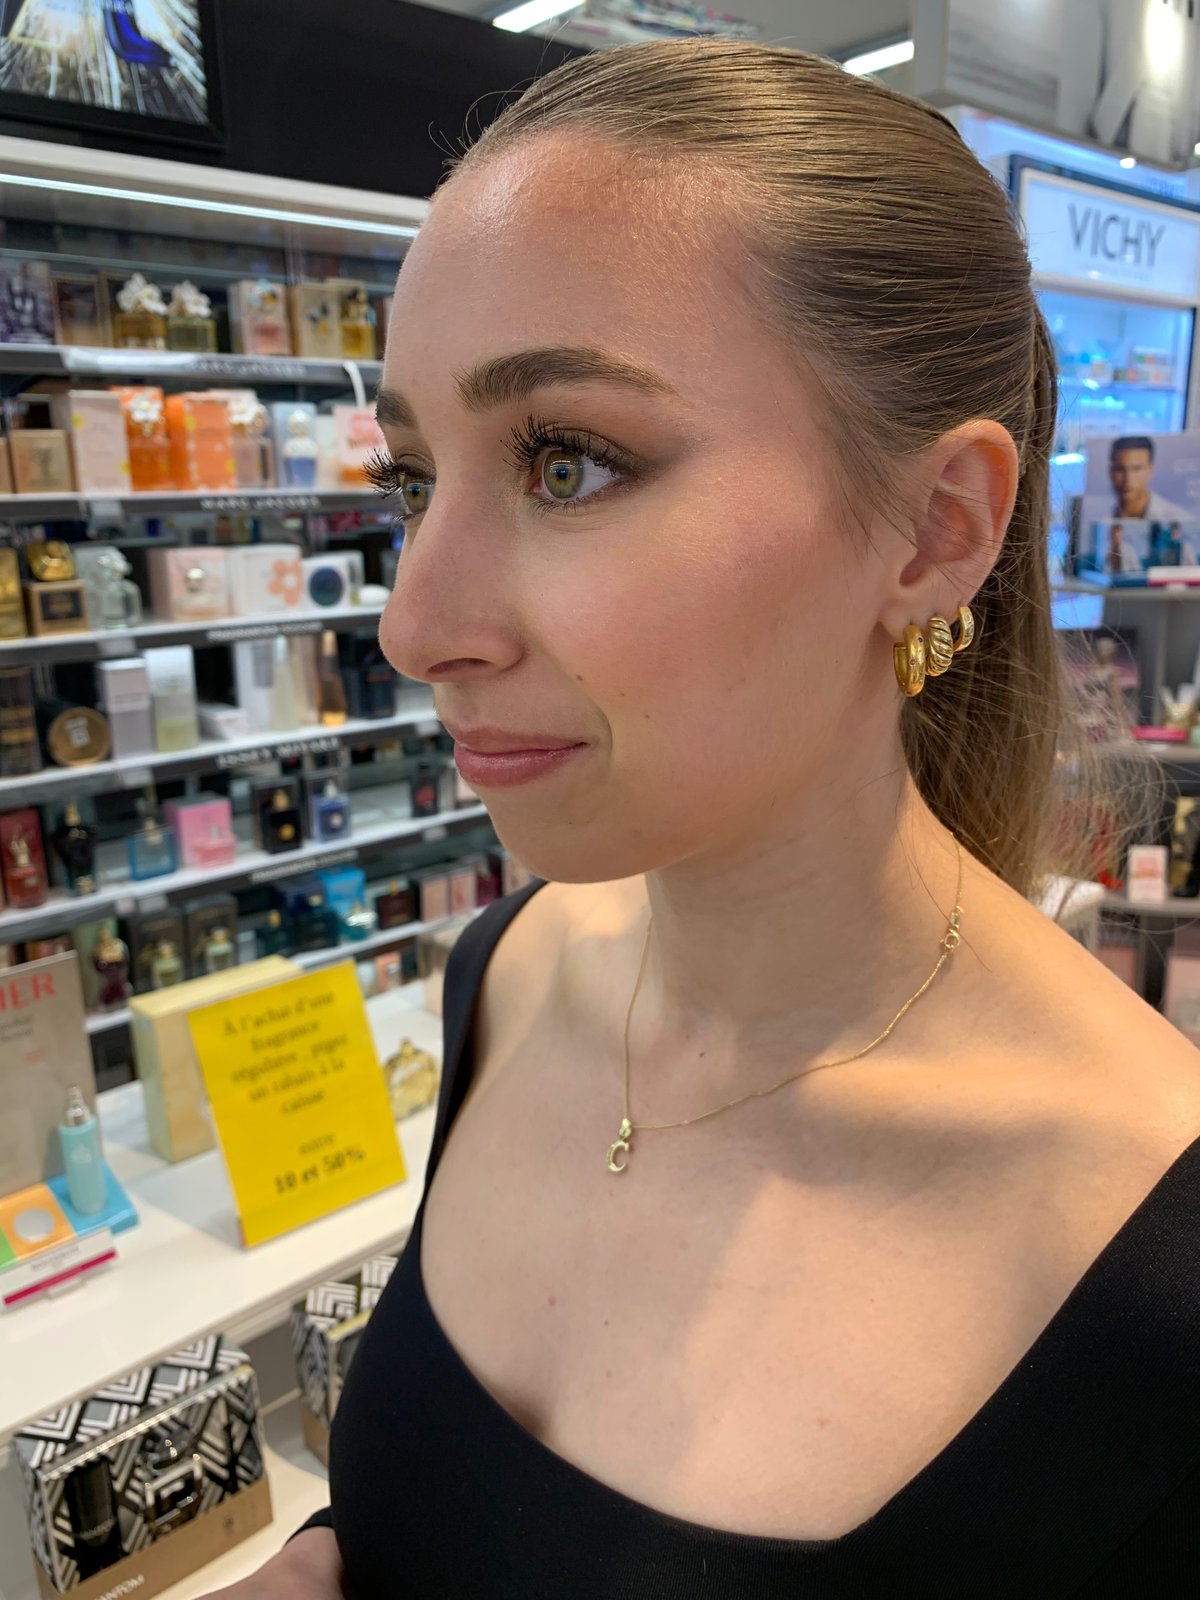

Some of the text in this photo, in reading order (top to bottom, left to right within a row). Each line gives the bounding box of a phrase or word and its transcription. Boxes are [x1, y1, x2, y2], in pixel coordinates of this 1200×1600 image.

[1067, 203, 1167, 268] VICHY
[201, 495, 321, 511] MARC JACOBS
[301, 1163, 320, 1184] et
